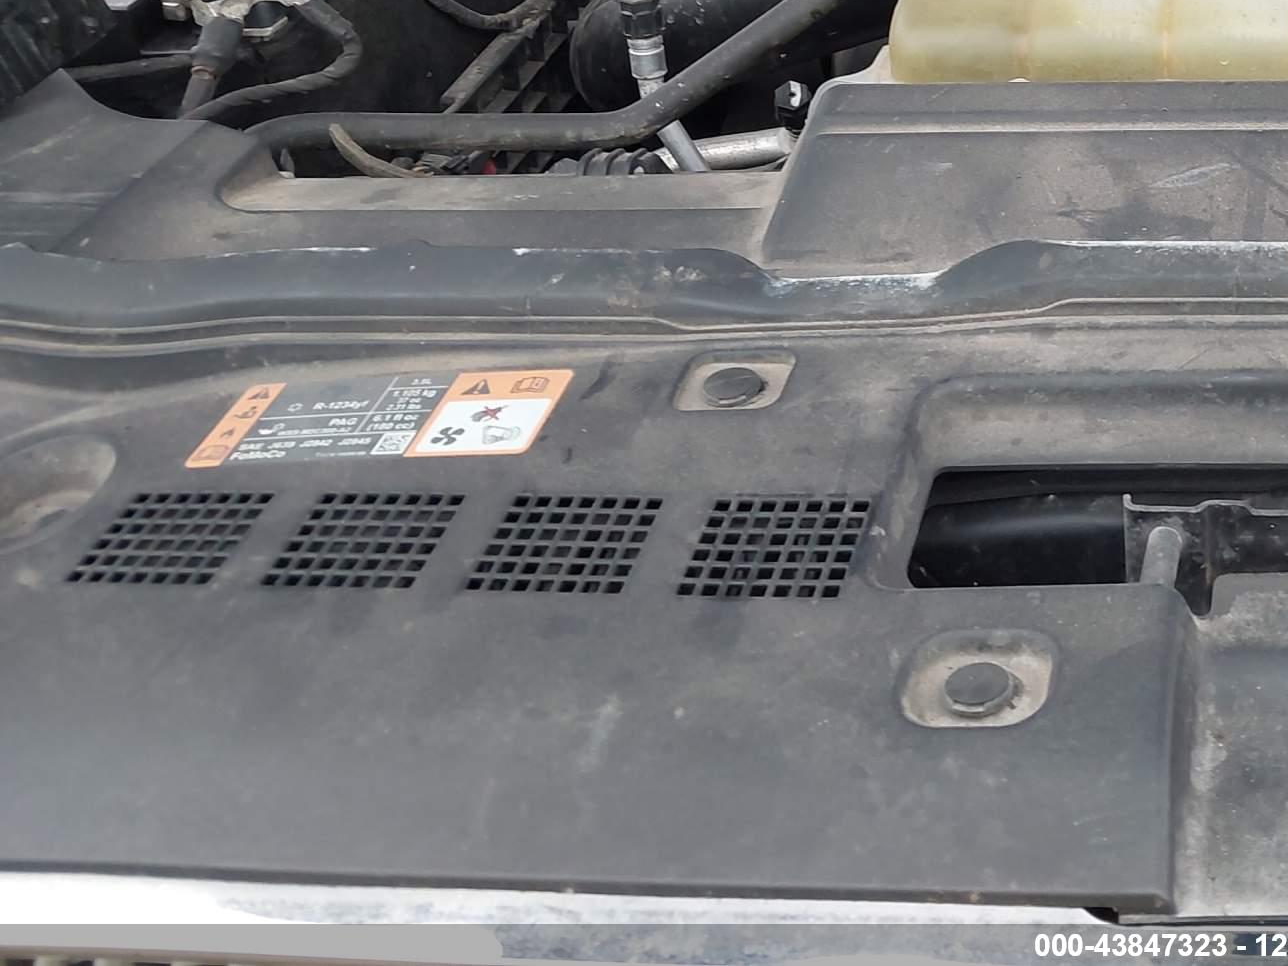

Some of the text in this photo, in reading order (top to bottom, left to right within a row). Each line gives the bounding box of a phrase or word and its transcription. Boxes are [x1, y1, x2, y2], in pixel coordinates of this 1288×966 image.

[311, 400, 370, 411] R-1234yf
[328, 418, 359, 428] PAG
[229, 449, 287, 461] FoMoCo
